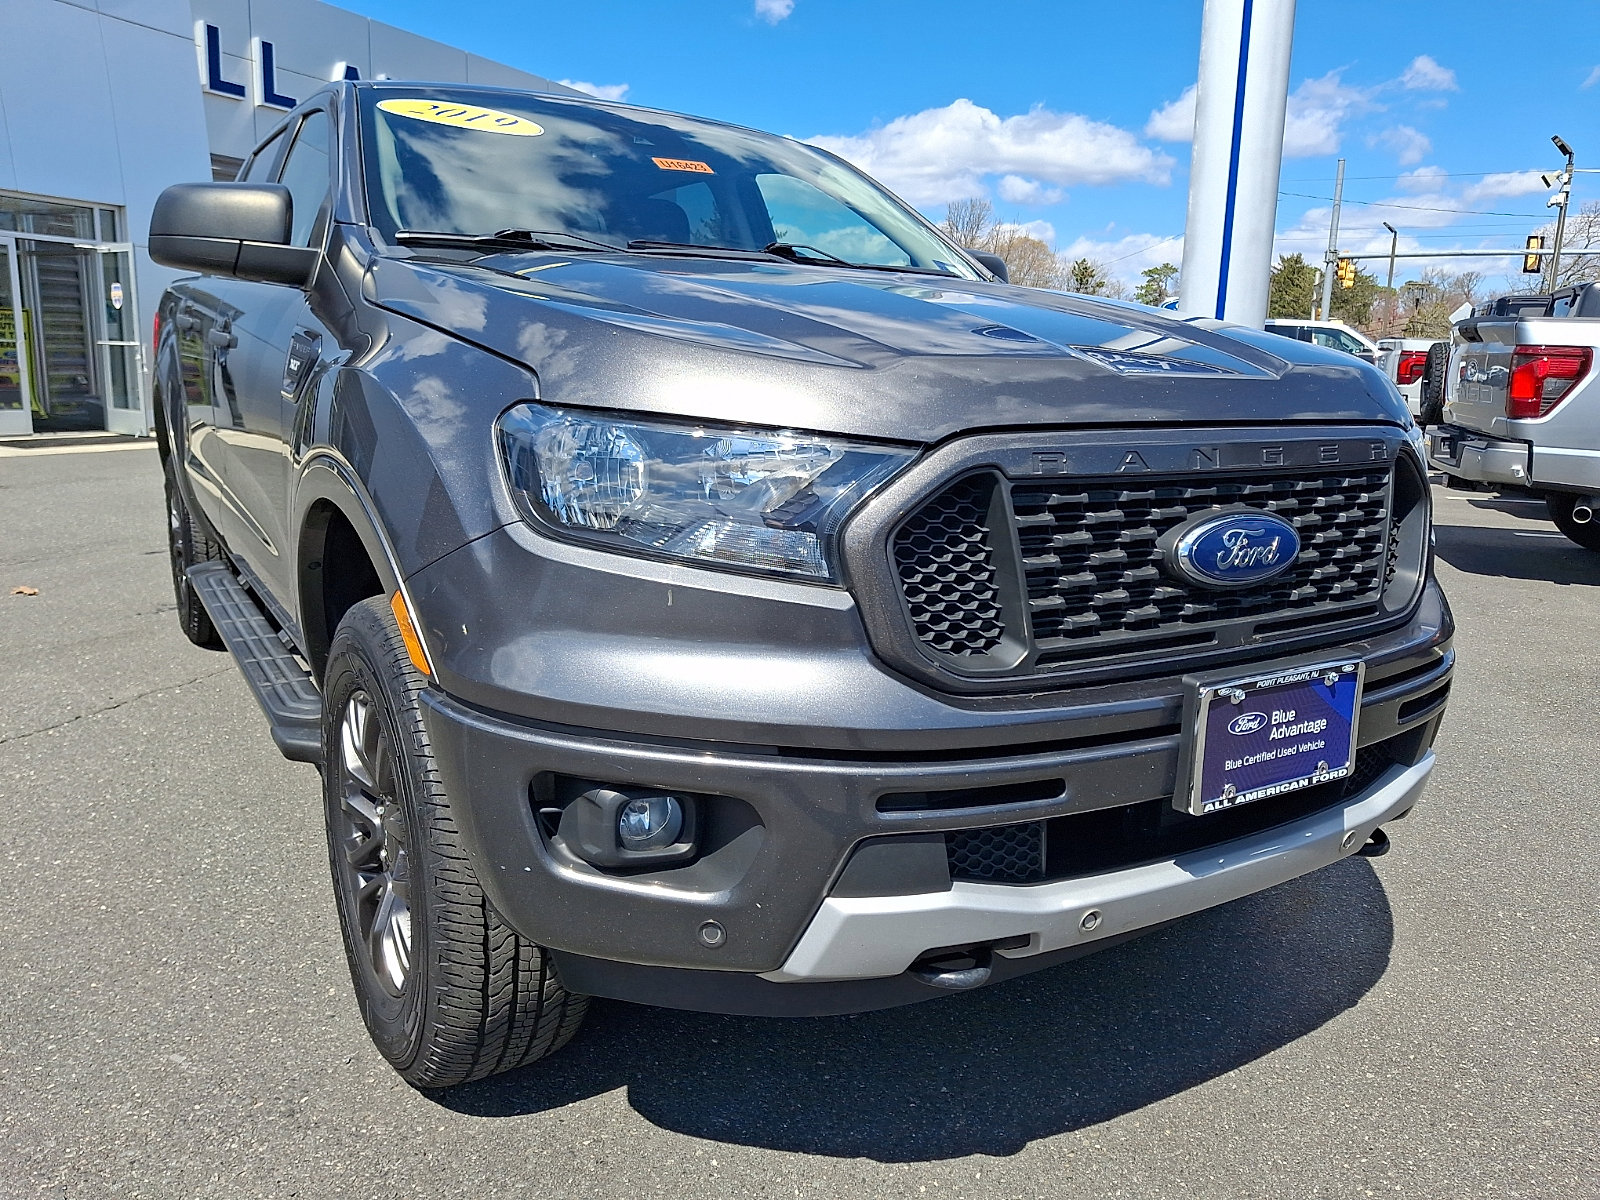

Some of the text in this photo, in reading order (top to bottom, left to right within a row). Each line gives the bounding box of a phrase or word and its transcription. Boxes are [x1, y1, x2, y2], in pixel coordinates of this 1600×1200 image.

[407, 104, 520, 127] 2019
[659, 160, 707, 172] U16423
[1031, 439, 1389, 475] RANGER
[1216, 527, 1282, 571] Ford
[1256, 678, 1277, 689] POINT
[1234, 715, 1260, 733] Ford
[1271, 709, 1296, 725] Blue
[1269, 717, 1327, 741] Advantage
[1224, 739, 1325, 771] Blue Certified Used Vehicle
[1203, 768, 1348, 813] ALL AMERICAN FORD
